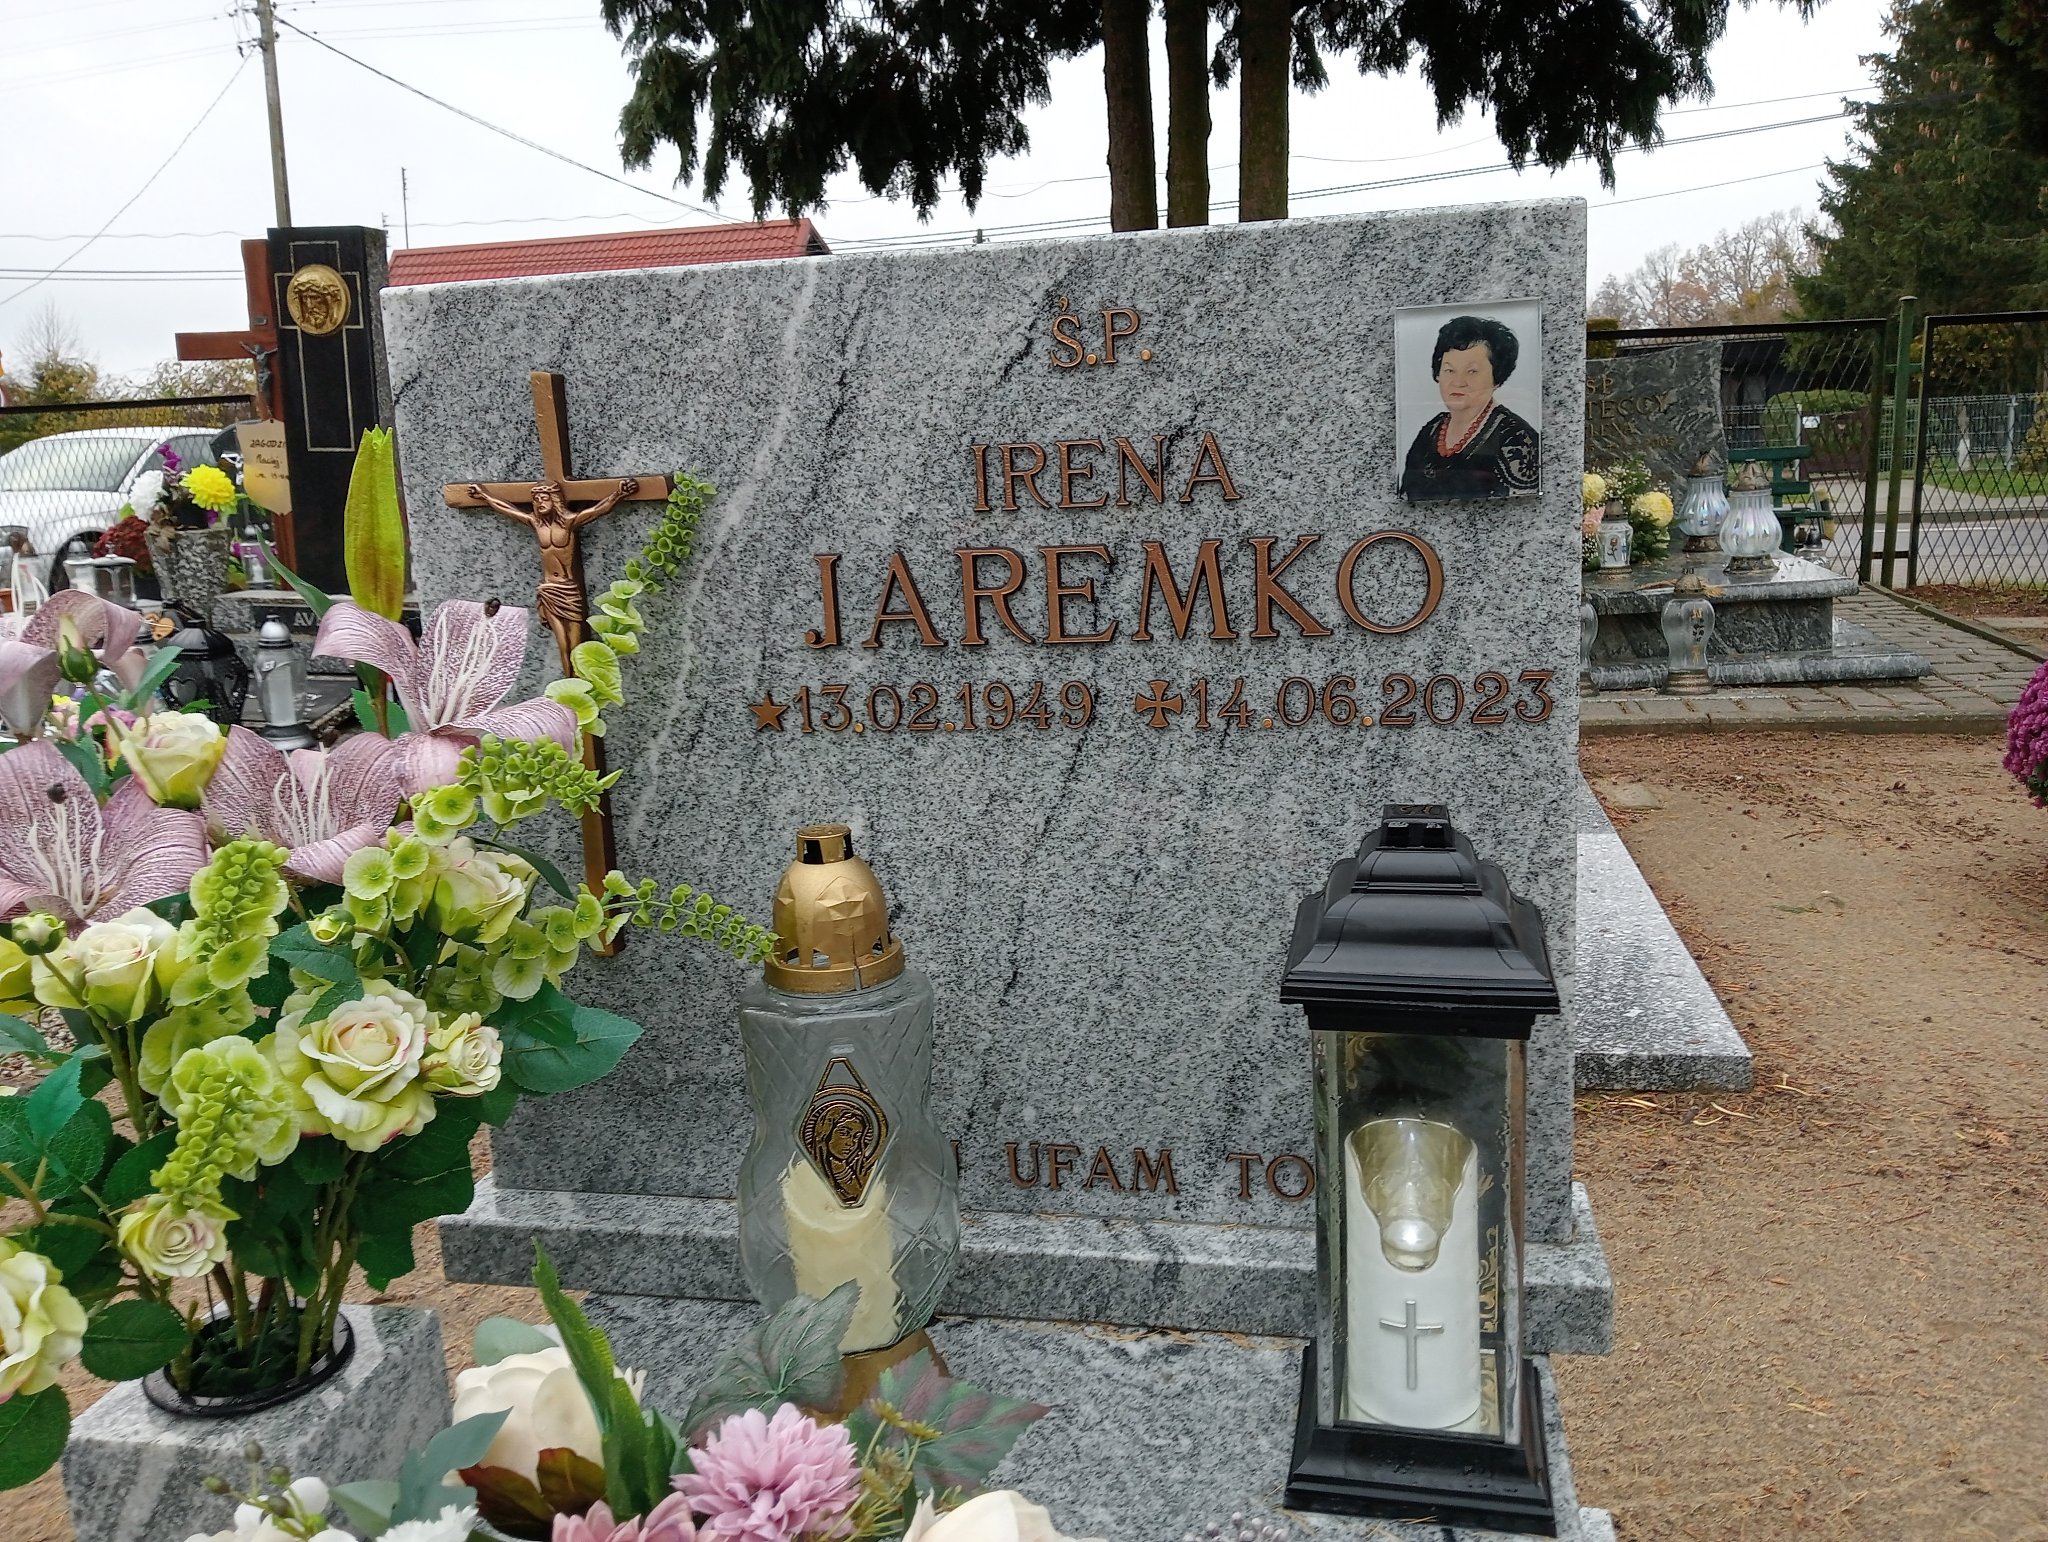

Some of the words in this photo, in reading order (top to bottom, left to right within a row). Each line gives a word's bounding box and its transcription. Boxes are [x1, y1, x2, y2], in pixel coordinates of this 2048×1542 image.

[1050, 296, 1151, 368] Ś.P.
[971, 431, 1241, 511] IRENA
[804, 529, 1445, 649] JAREMKO
[788, 681, 1096, 734] 13.02.1949
[1190, 670, 1556, 729] 14.06.2023
[1004, 1141, 1181, 1196] UFAM
